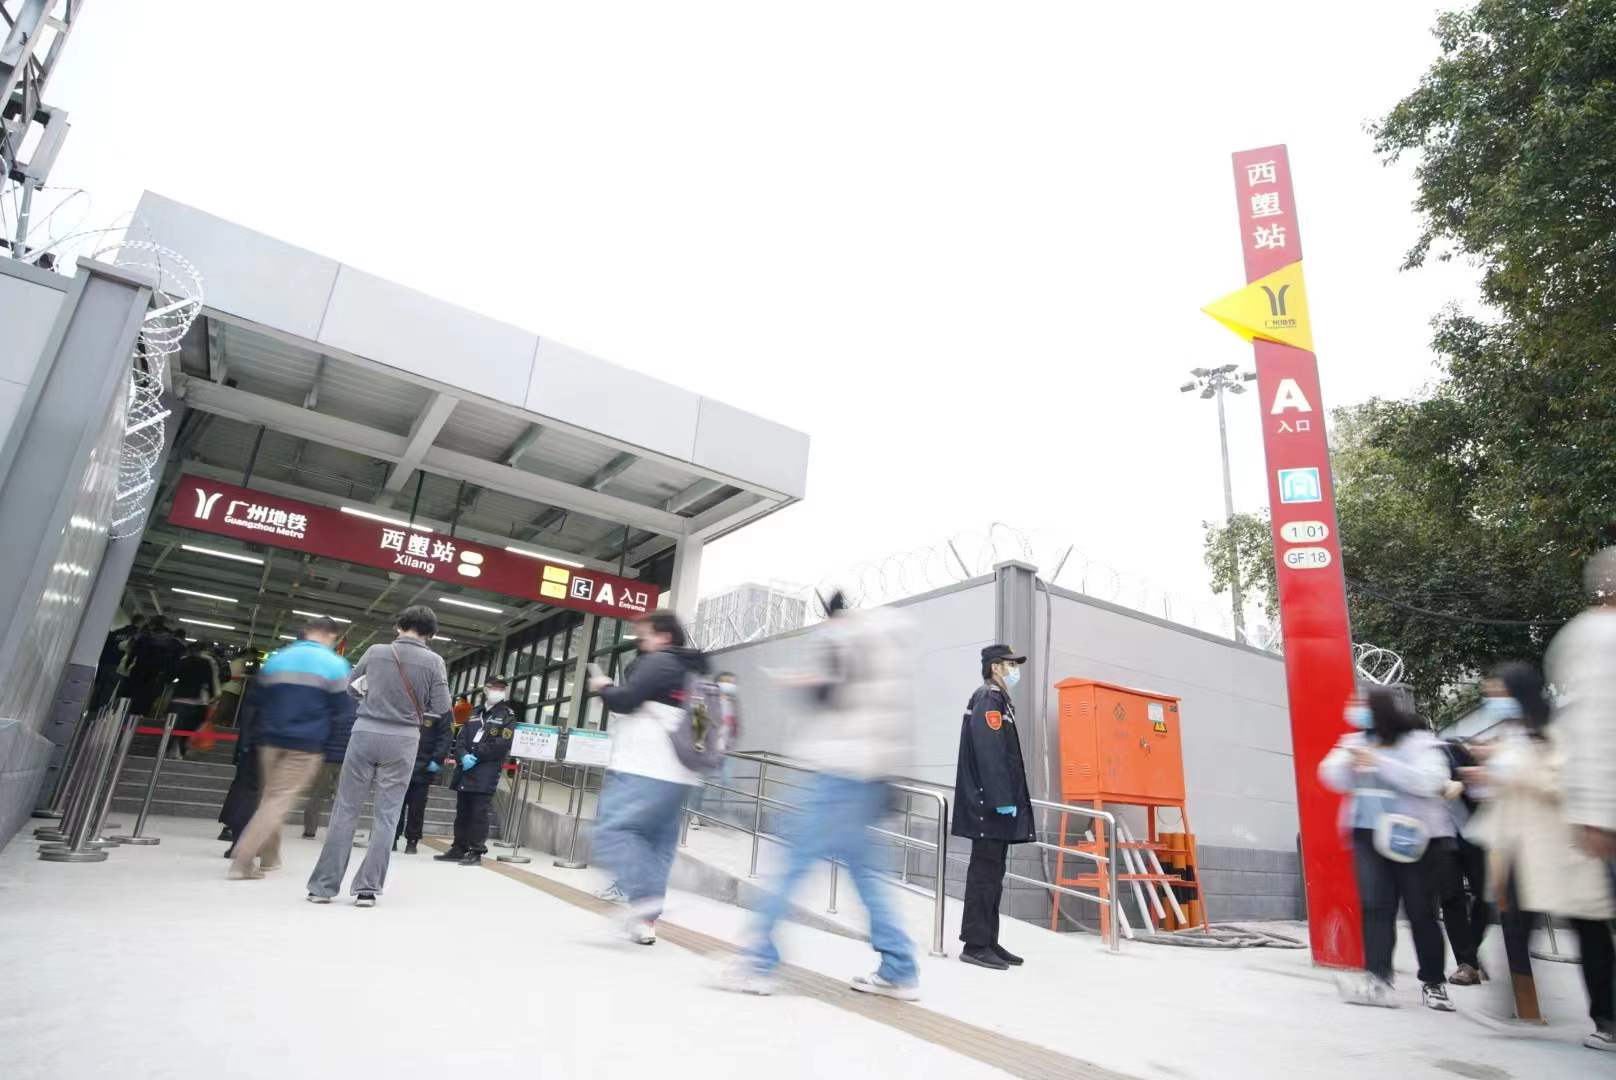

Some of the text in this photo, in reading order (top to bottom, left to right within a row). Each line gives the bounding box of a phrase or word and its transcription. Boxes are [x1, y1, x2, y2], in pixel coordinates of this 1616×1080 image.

[1245, 160, 1286, 249] 西塱站
[1271, 378, 1312, 414] A
[1277, 419, 1311, 433] 入口
[224, 515, 305, 539] Guangzhou Metro
[226, 500, 307, 532] 广州地铁
[380, 528, 456, 563] 西塱站
[393, 553, 436, 574] Xilang
[594, 582, 648, 606] A 入口
[618, 601, 646, 612] Entrance
